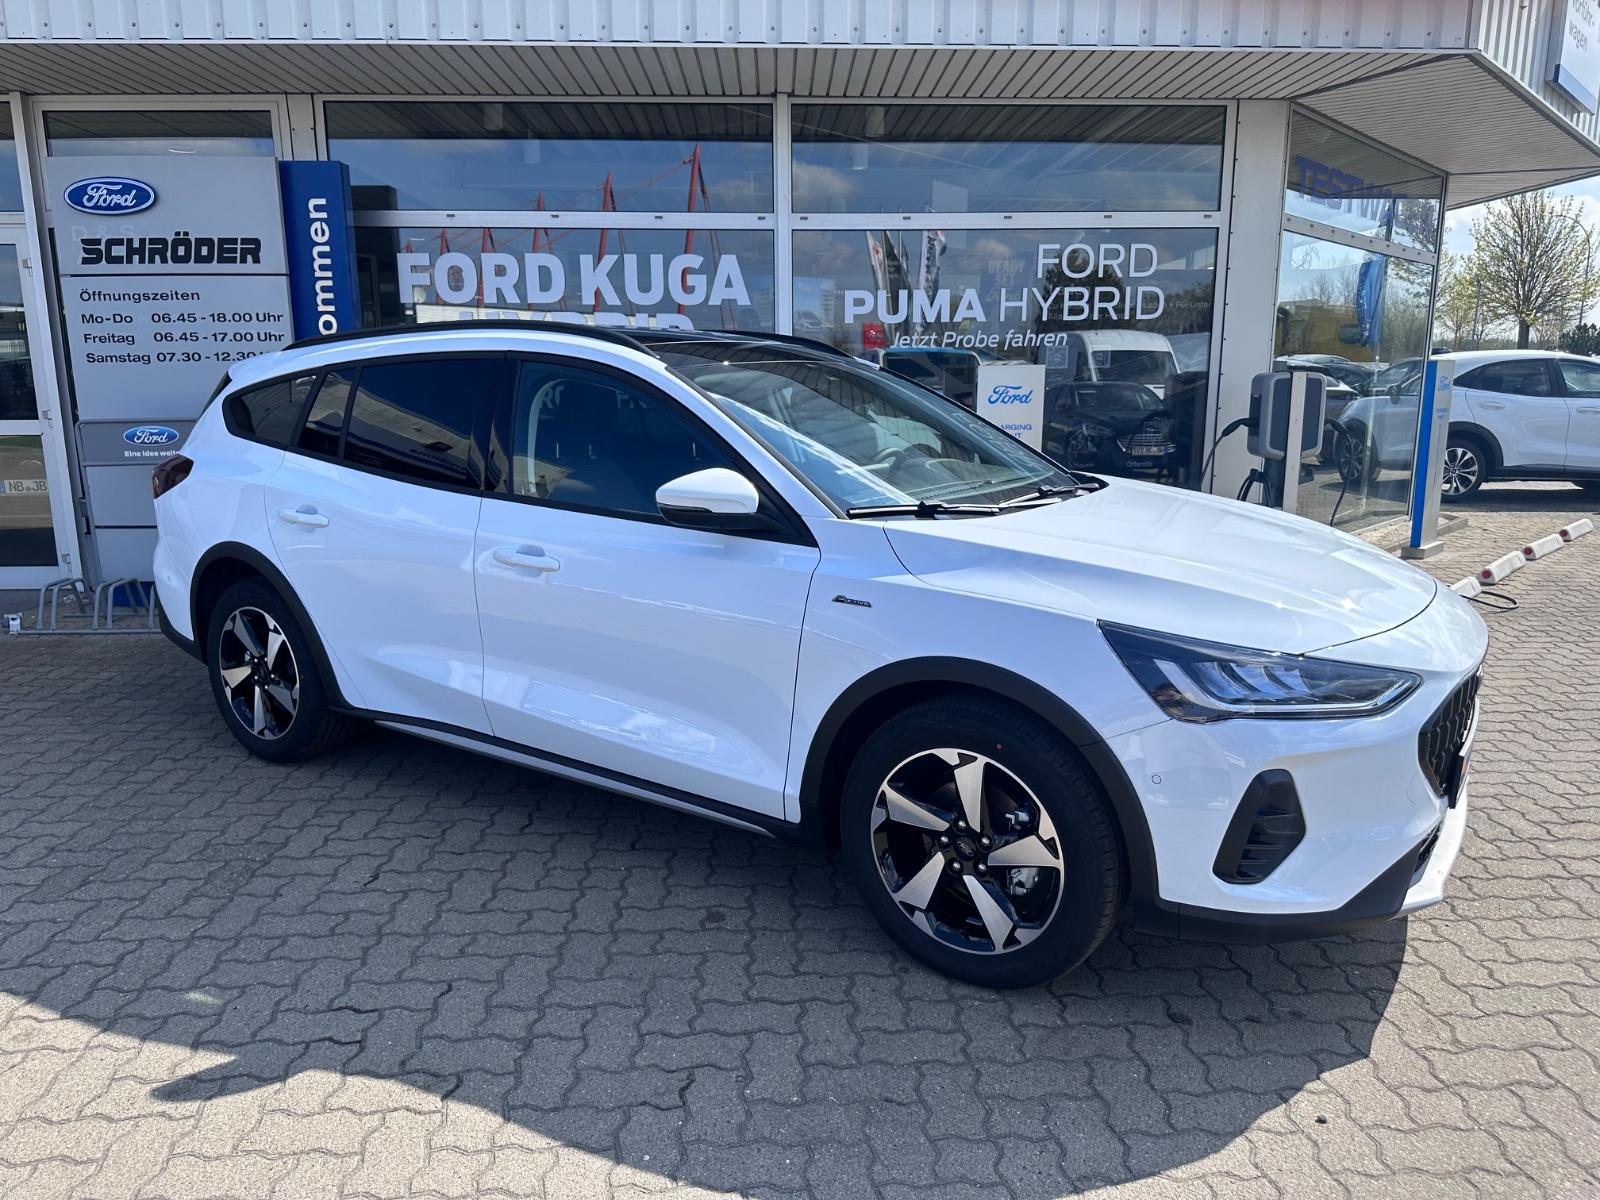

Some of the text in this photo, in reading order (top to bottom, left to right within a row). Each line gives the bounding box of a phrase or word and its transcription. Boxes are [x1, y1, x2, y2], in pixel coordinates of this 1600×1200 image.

[1569, 20, 1588, 52] wagen
[80, 231, 261, 265] SCHRÖDER
[308, 198, 337, 336] ommen
[1036, 243, 1158, 279] FORD
[397, 252, 751, 306] FORD KUGA
[79, 288, 201, 304] Öffnungszeiten
[844, 288, 987, 324] PUMA
[1000, 286, 1165, 322] HYBRID
[81, 313, 133, 324] Mo-Do
[151, 312, 197, 323] 06.45
[211, 312, 252, 323] 18.00
[256, 312, 284, 323] Uhr
[84, 332, 136, 345] Freitag
[153, 332, 200, 342] 06.45
[213, 332, 254, 342] 17.00
[257, 331, 285, 342] Uhr
[890, 332, 938, 349] Jetzt
[941, 330, 1000, 349] Probe
[1003, 329, 1068, 351] fahren
[86, 352, 151, 365] Samstag
[156, 352, 202, 362] 07.30
[988, 385, 1033, 404] Ford
[134, 428, 169, 444] Ford
[124, 450, 142, 458] Eine
[8, 480, 48, 492] NB JB
